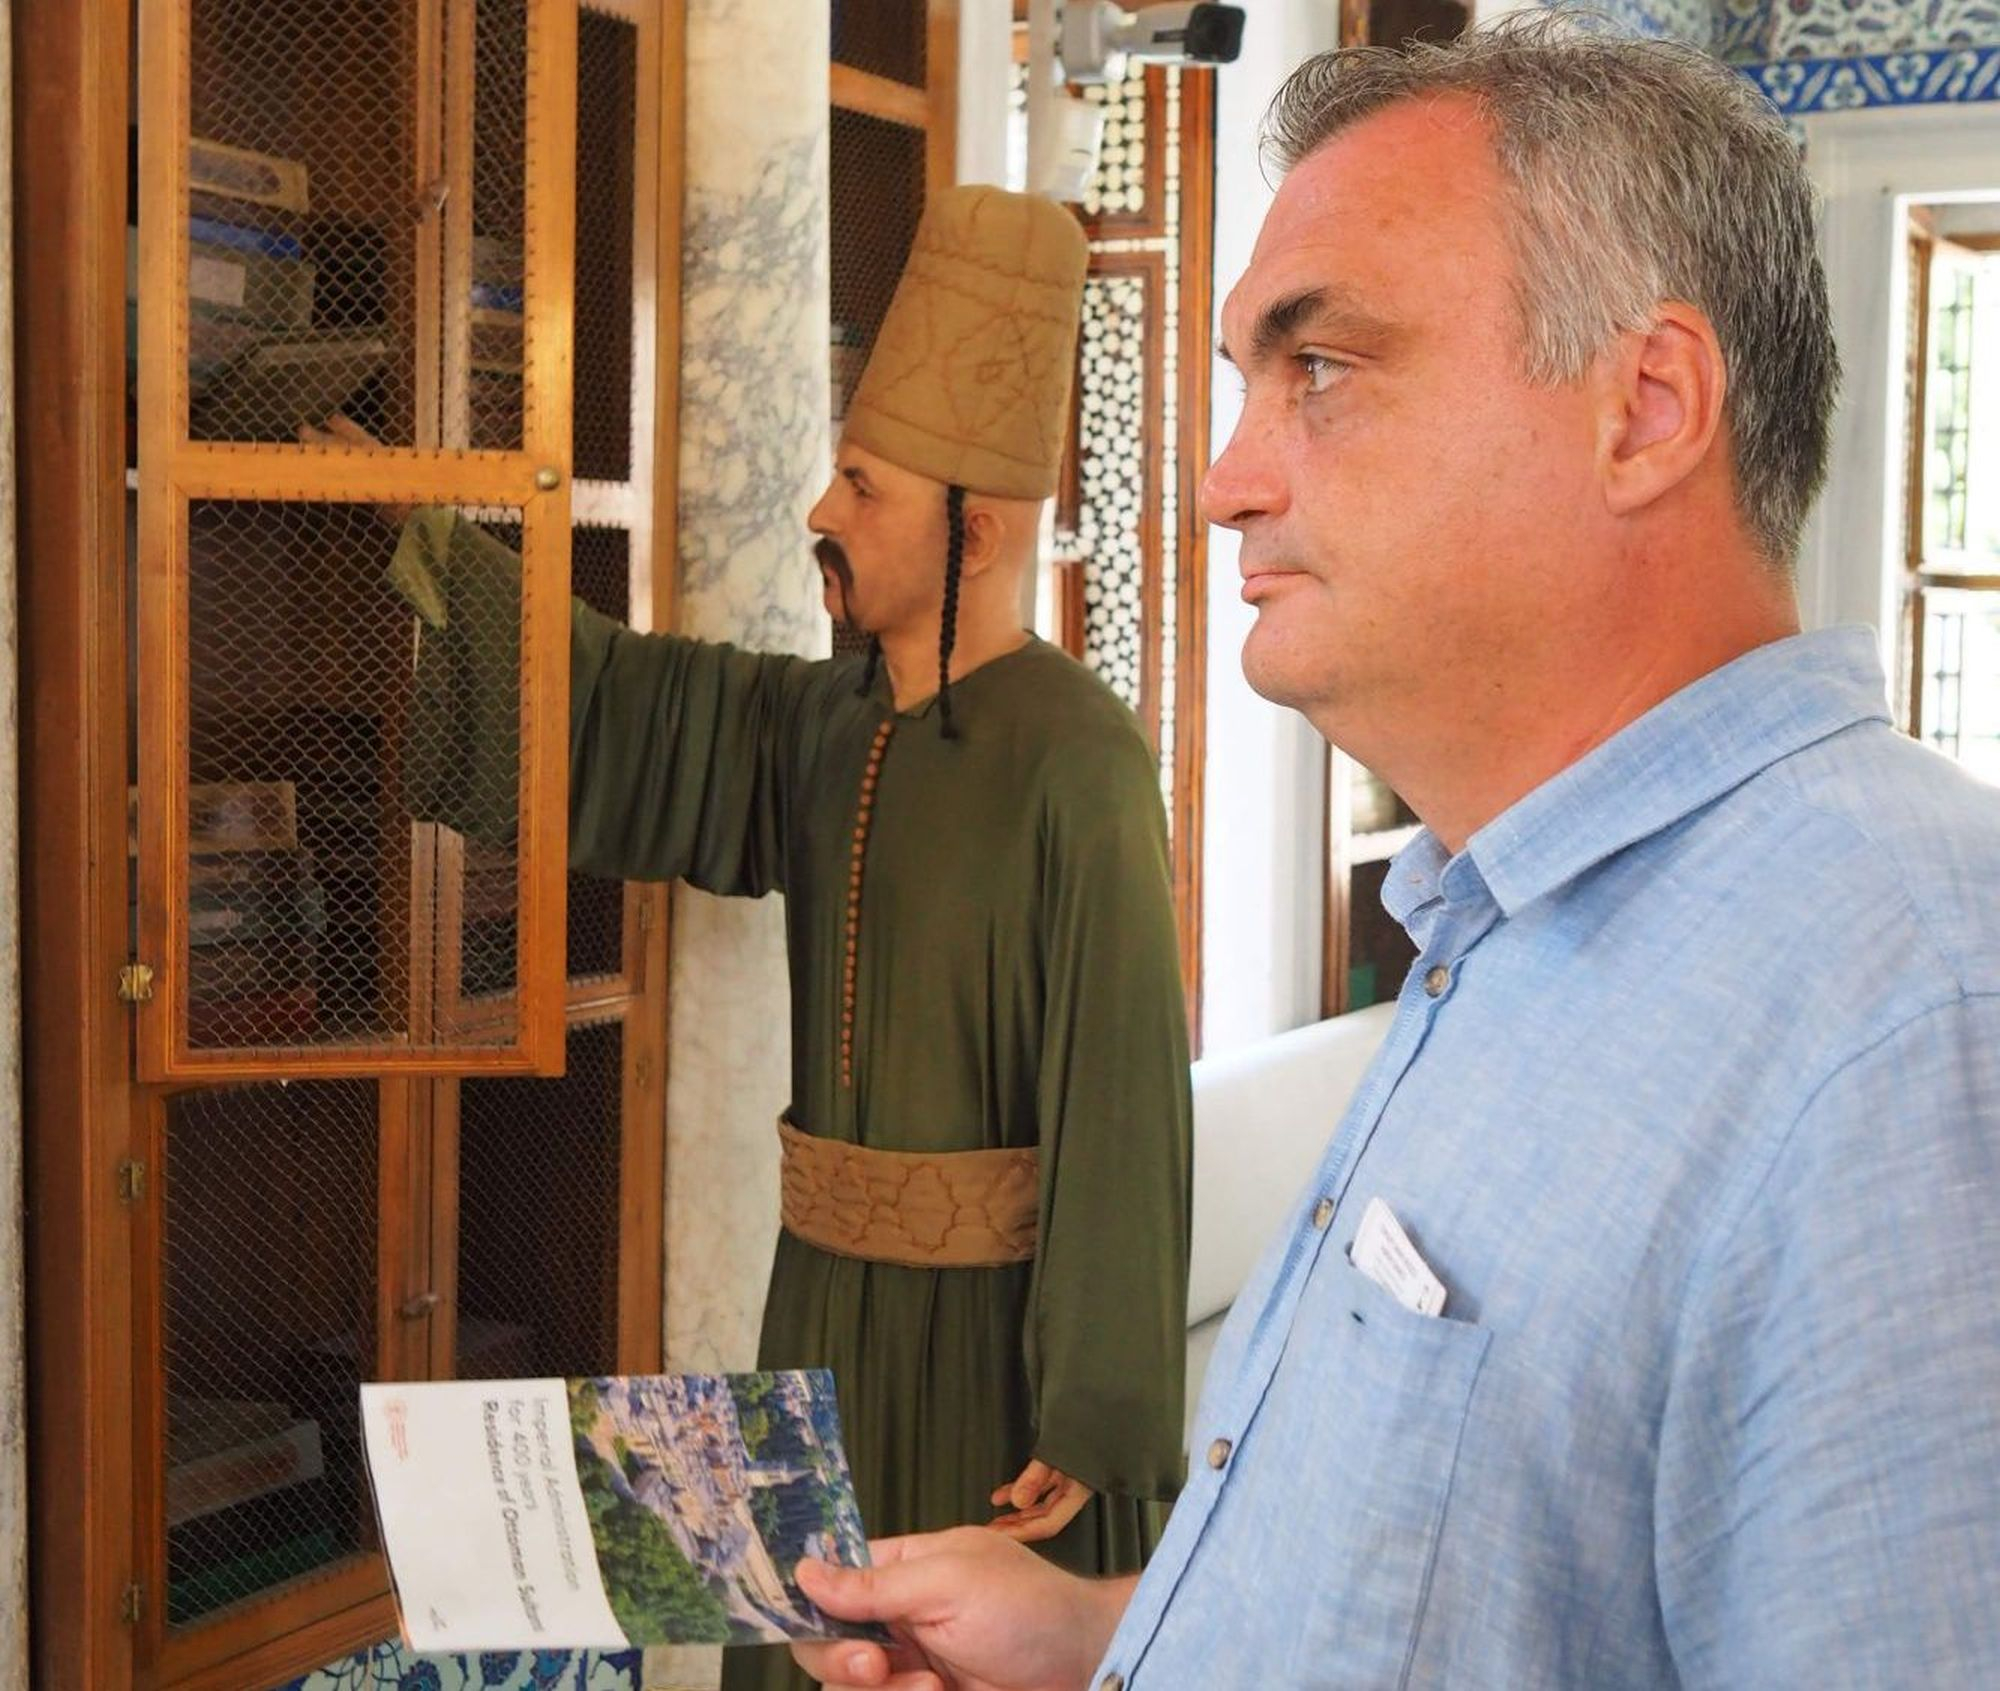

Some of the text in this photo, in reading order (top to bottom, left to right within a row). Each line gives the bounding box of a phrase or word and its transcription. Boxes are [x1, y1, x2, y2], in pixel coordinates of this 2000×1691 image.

[508, 1399, 525, 1425] for
[512, 1432, 531, 1465] 400
[497, 1489, 516, 1504] of
[533, 1398, 580, 1590] Imperial Administration
[502, 1507, 526, 1580] Ottoman
